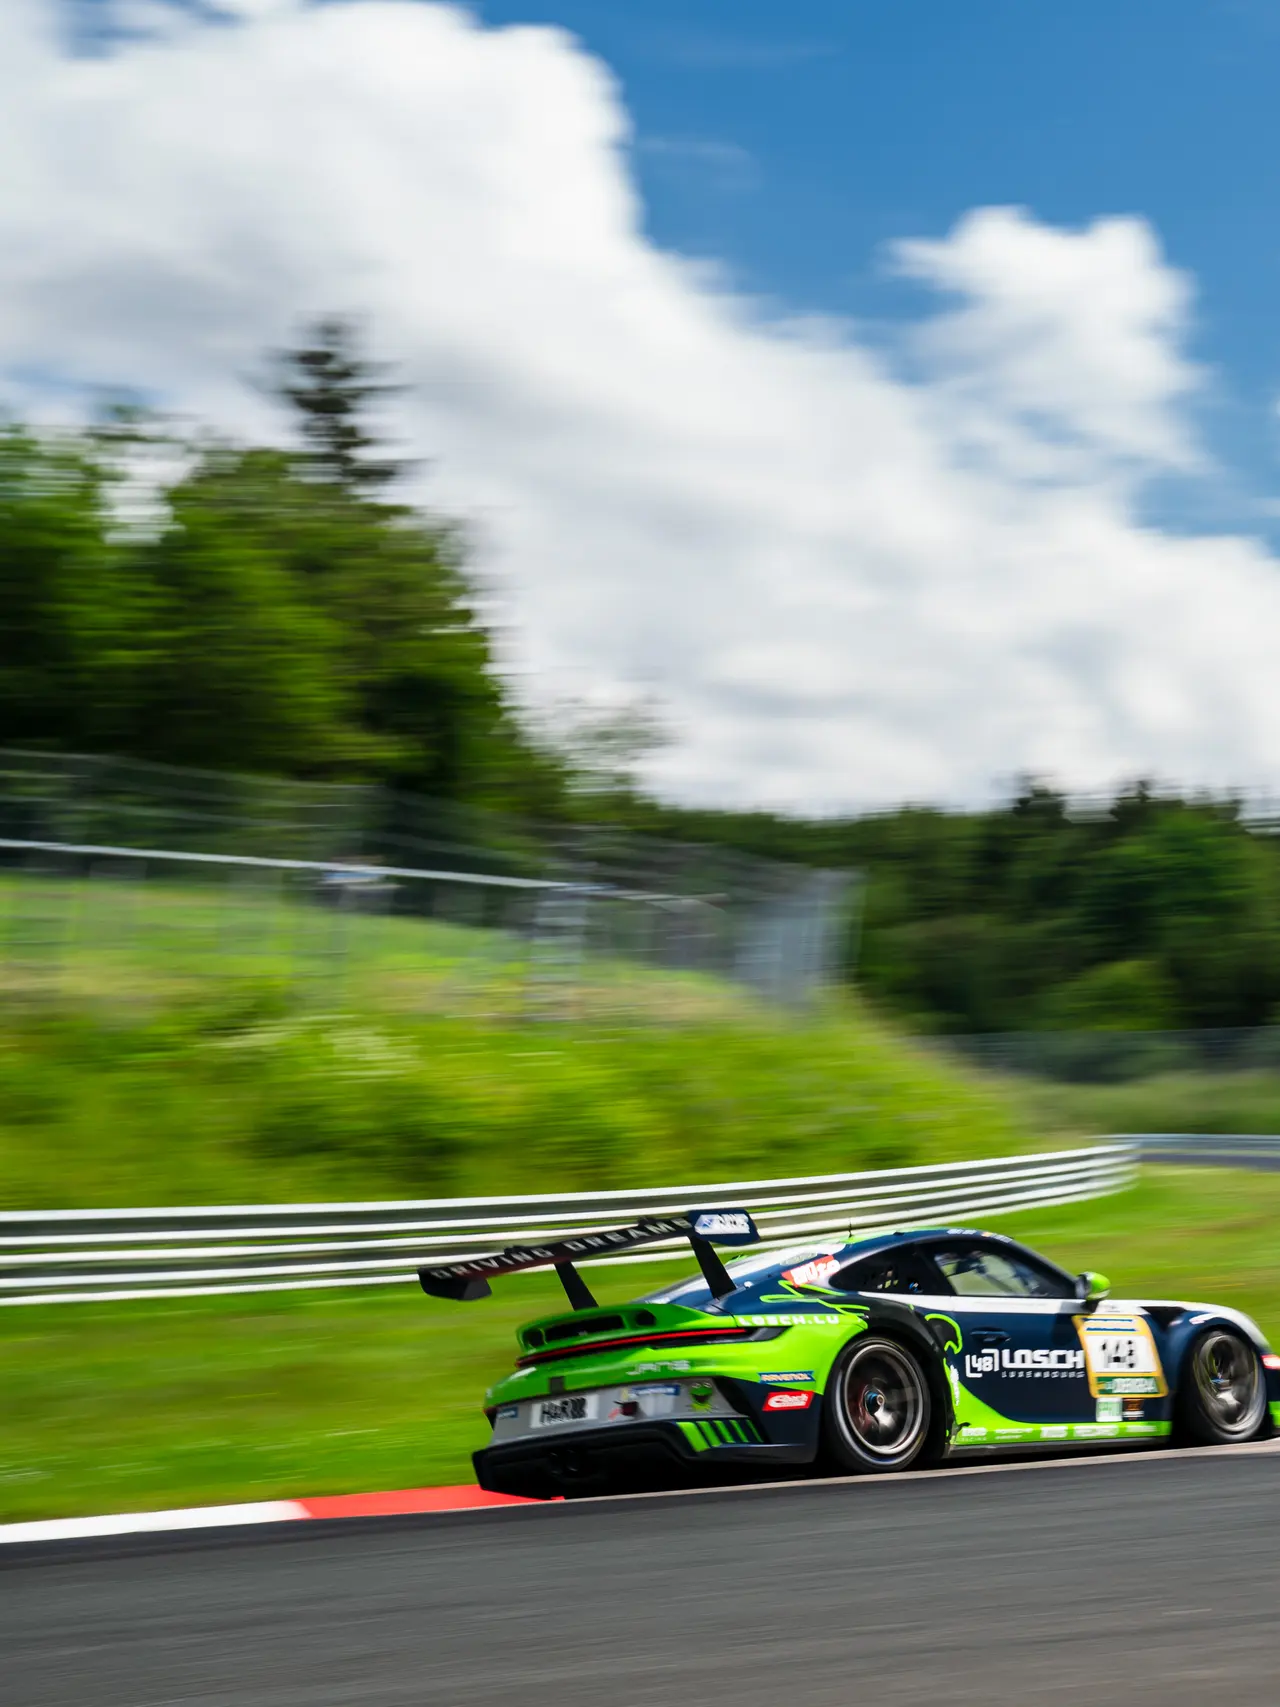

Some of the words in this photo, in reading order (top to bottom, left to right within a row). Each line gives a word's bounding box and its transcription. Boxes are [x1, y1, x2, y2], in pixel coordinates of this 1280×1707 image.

[429, 1247, 555, 1281] DRIVING
[562, 1216, 693, 1251] DREAMS
[1001, 1348, 1085, 1369] LOSCH
